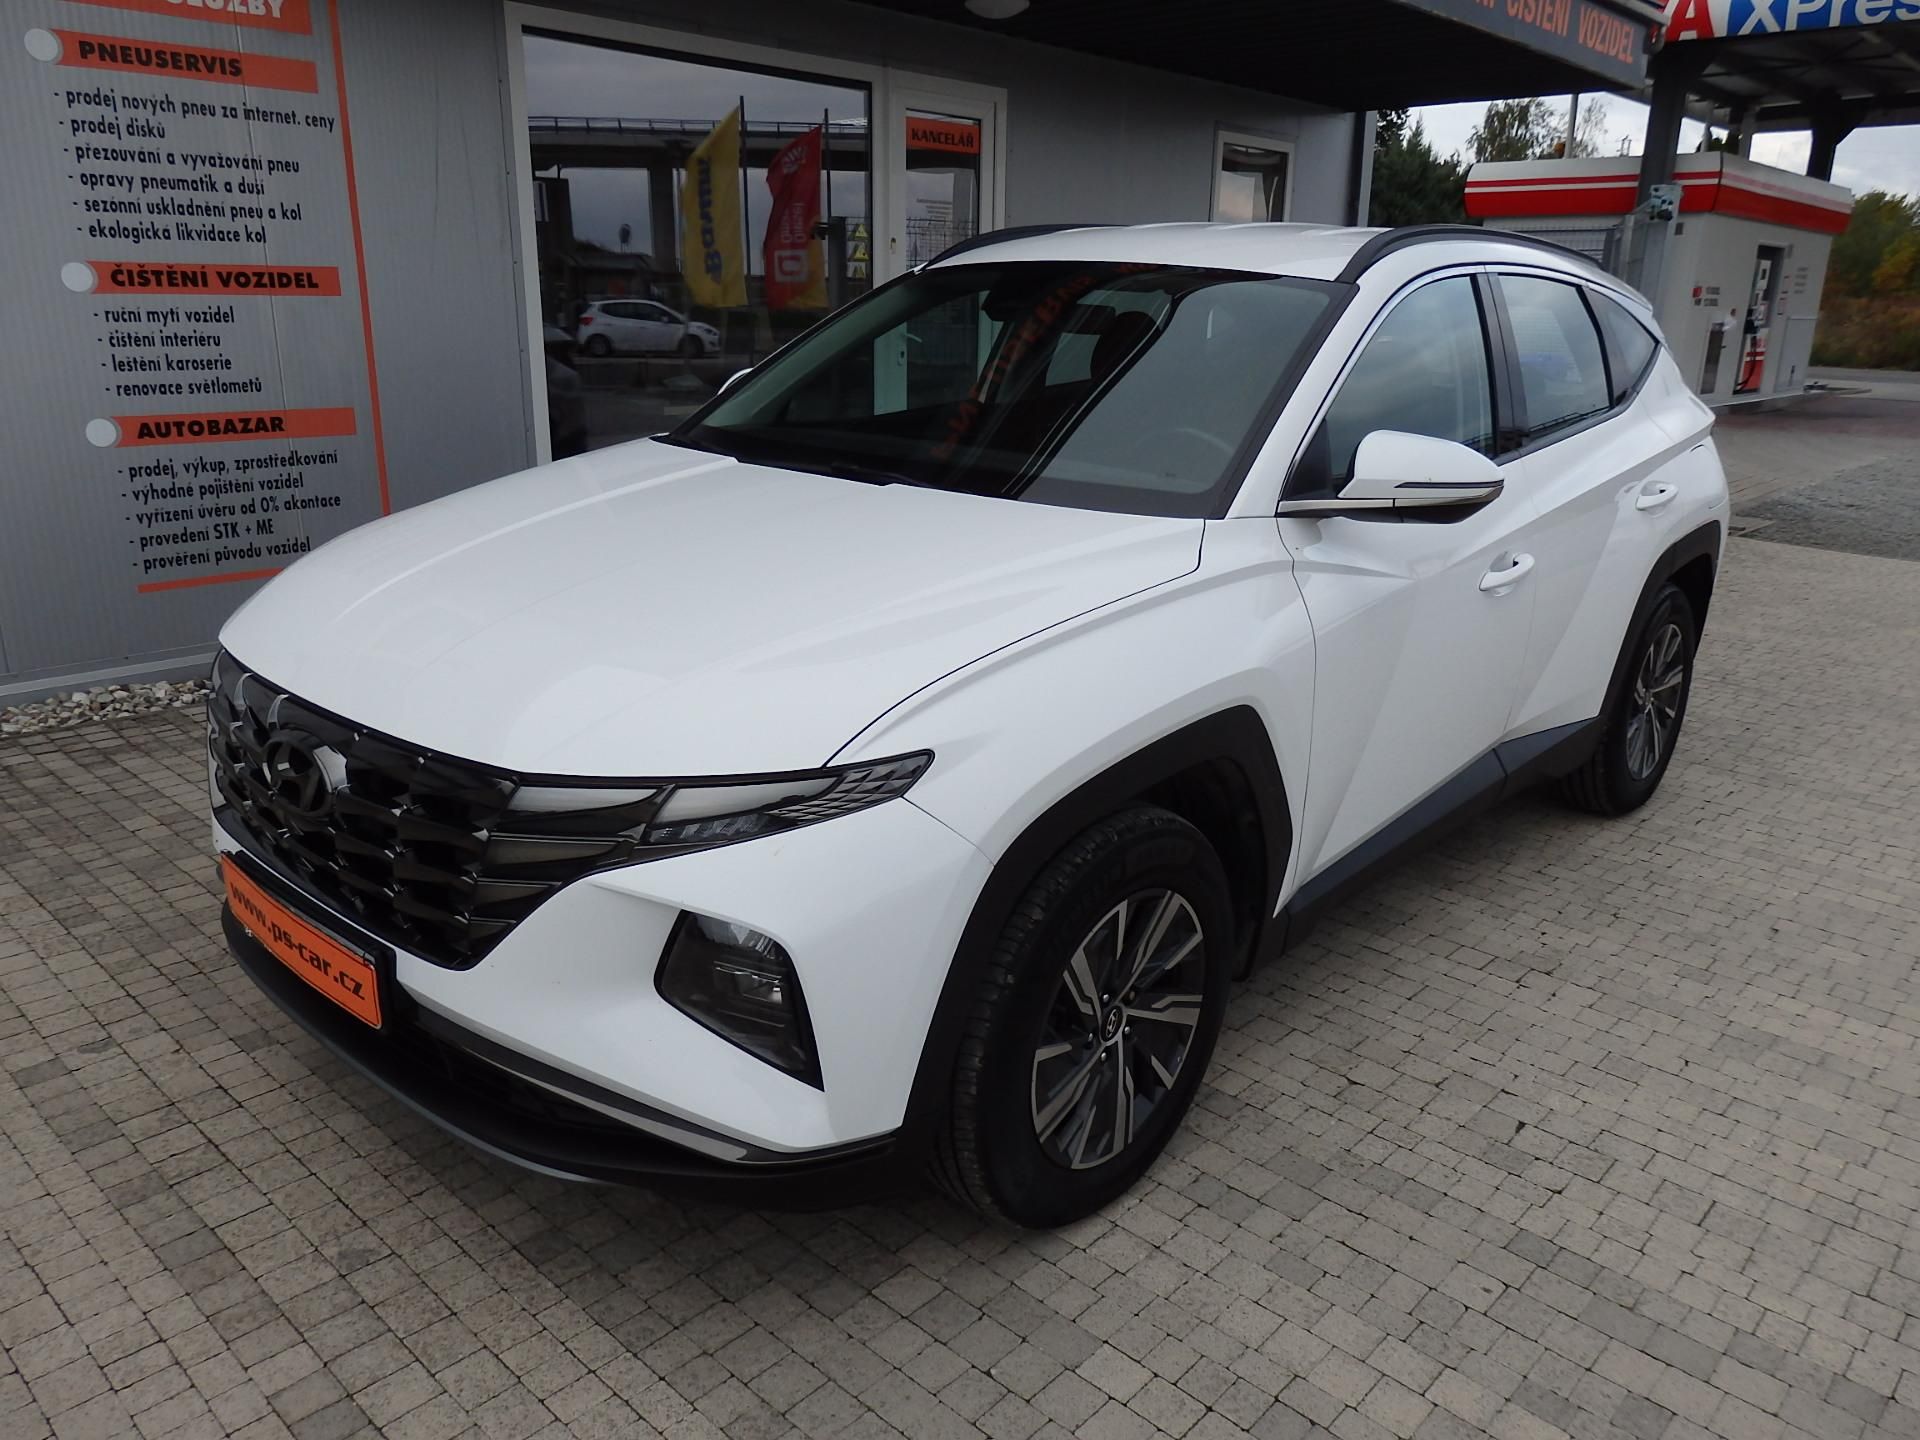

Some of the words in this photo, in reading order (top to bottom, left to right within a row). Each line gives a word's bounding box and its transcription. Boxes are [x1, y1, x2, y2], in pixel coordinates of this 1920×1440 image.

[1578, 4, 1634, 64] VOZIDEL
[79, 40, 243, 77] PNEUSERVIS
[66, 87, 117, 113] prodej
[121, 93, 176, 116] nových
[181, 101, 216, 119] pneu
[221, 105, 238, 119] za
[242, 101, 301, 126] internet.
[305, 113, 335, 133] ceny
[70, 114, 121, 141] prodej
[75, 142, 161, 164] přezouvání
[166, 152, 176, 165] a
[181, 152, 263, 171] vyvažování
[267, 159, 299, 176] pneu
[80, 173, 134, 193] opravy
[140, 174, 219, 194] pneumatik
[224, 181, 233, 194] a
[147, 196, 225, 217] uskladnění
[229, 205, 263, 222] pneu
[268, 207, 276, 220] a
[280, 201, 302, 221] kol
[89, 218, 171, 244] ekologická
[176, 221, 240, 242] likvidace
[244, 224, 267, 244] kol
[111, 264, 208, 288] ČIŠTĚNÍ
[216, 270, 319, 289] VOZIDEL
[104, 306, 141, 323] ruční
[185, 305, 234, 323] vozidel
[109, 329, 155, 348] čištění
[160, 329, 221, 347] interiéru
[112, 353, 161, 372] leštění
[165, 353, 231, 371] karoserie
[116, 383, 183, 397] renovace
[188, 376, 262, 395] světlometů
[138, 416, 286, 440] AUTOBAZAR
[128, 458, 178, 483] prodej,
[183, 455, 230, 478] výkup,
[234, 449, 338, 475] zprostředkování
[132, 481, 194, 505] výhodné
[199, 477, 255, 501] pojištění
[258, 471, 304, 491] vozidel
[198, 503, 236, 519] úvěru
[240, 497, 256, 515] od
[260, 495, 280, 513] 0%
[284, 494, 341, 511] akontace
[140, 526, 209, 552] provedení
[213, 521, 240, 540] STK
[256, 518, 275, 535] ME
[143, 548, 211, 575] prověření
[214, 541, 262, 567] původu
[266, 535, 311, 555] vozidel
[229, 882, 367, 1001] www.ps-car.cz
